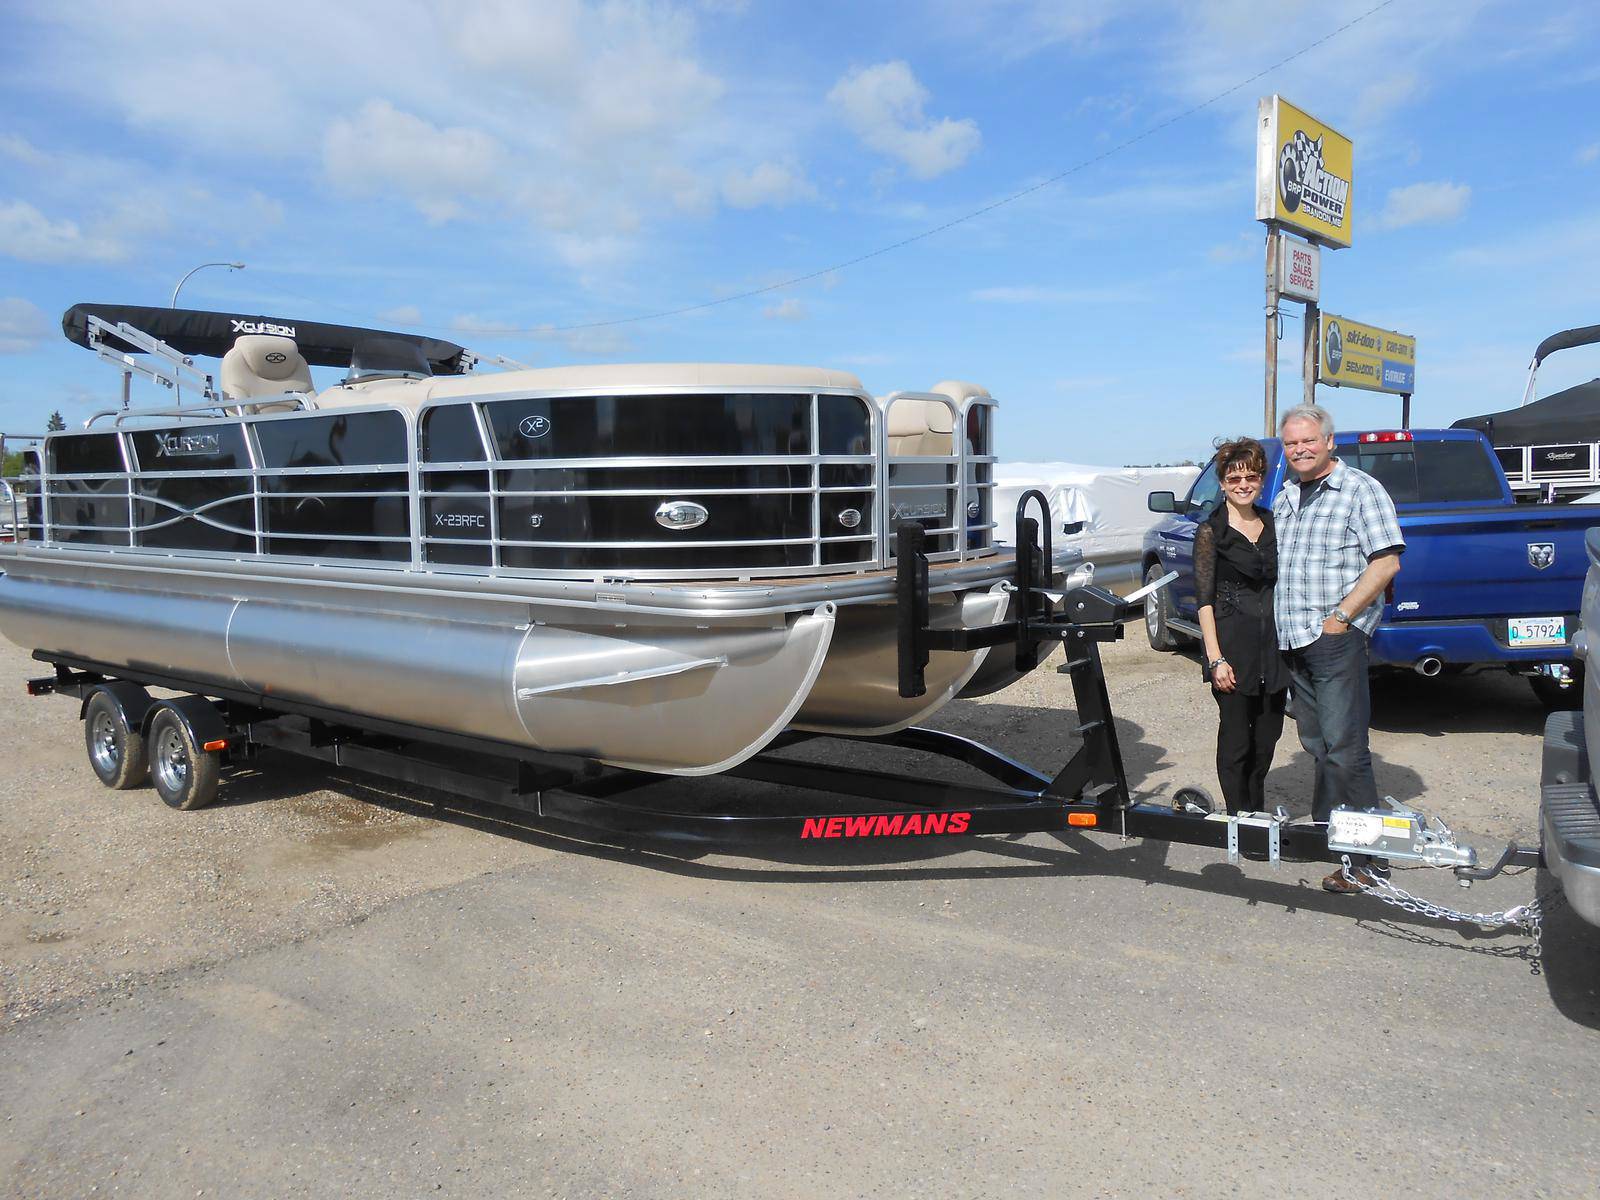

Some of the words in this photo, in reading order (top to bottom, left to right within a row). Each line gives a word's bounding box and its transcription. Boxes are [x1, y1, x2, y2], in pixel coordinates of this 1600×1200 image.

[1302, 154, 1349, 204] ACTION
[1287, 180, 1302, 195] BRP
[1303, 188, 1342, 214] POWER
[1293, 250, 1312, 266] PARTS
[1293, 262, 1312, 278] SALES
[1289, 273, 1314, 290] SERVICE
[435, 514, 485, 527] X-23RFC
[1526, 624, 1563, 638] 57924
[801, 812, 972, 839] NEWMANS
